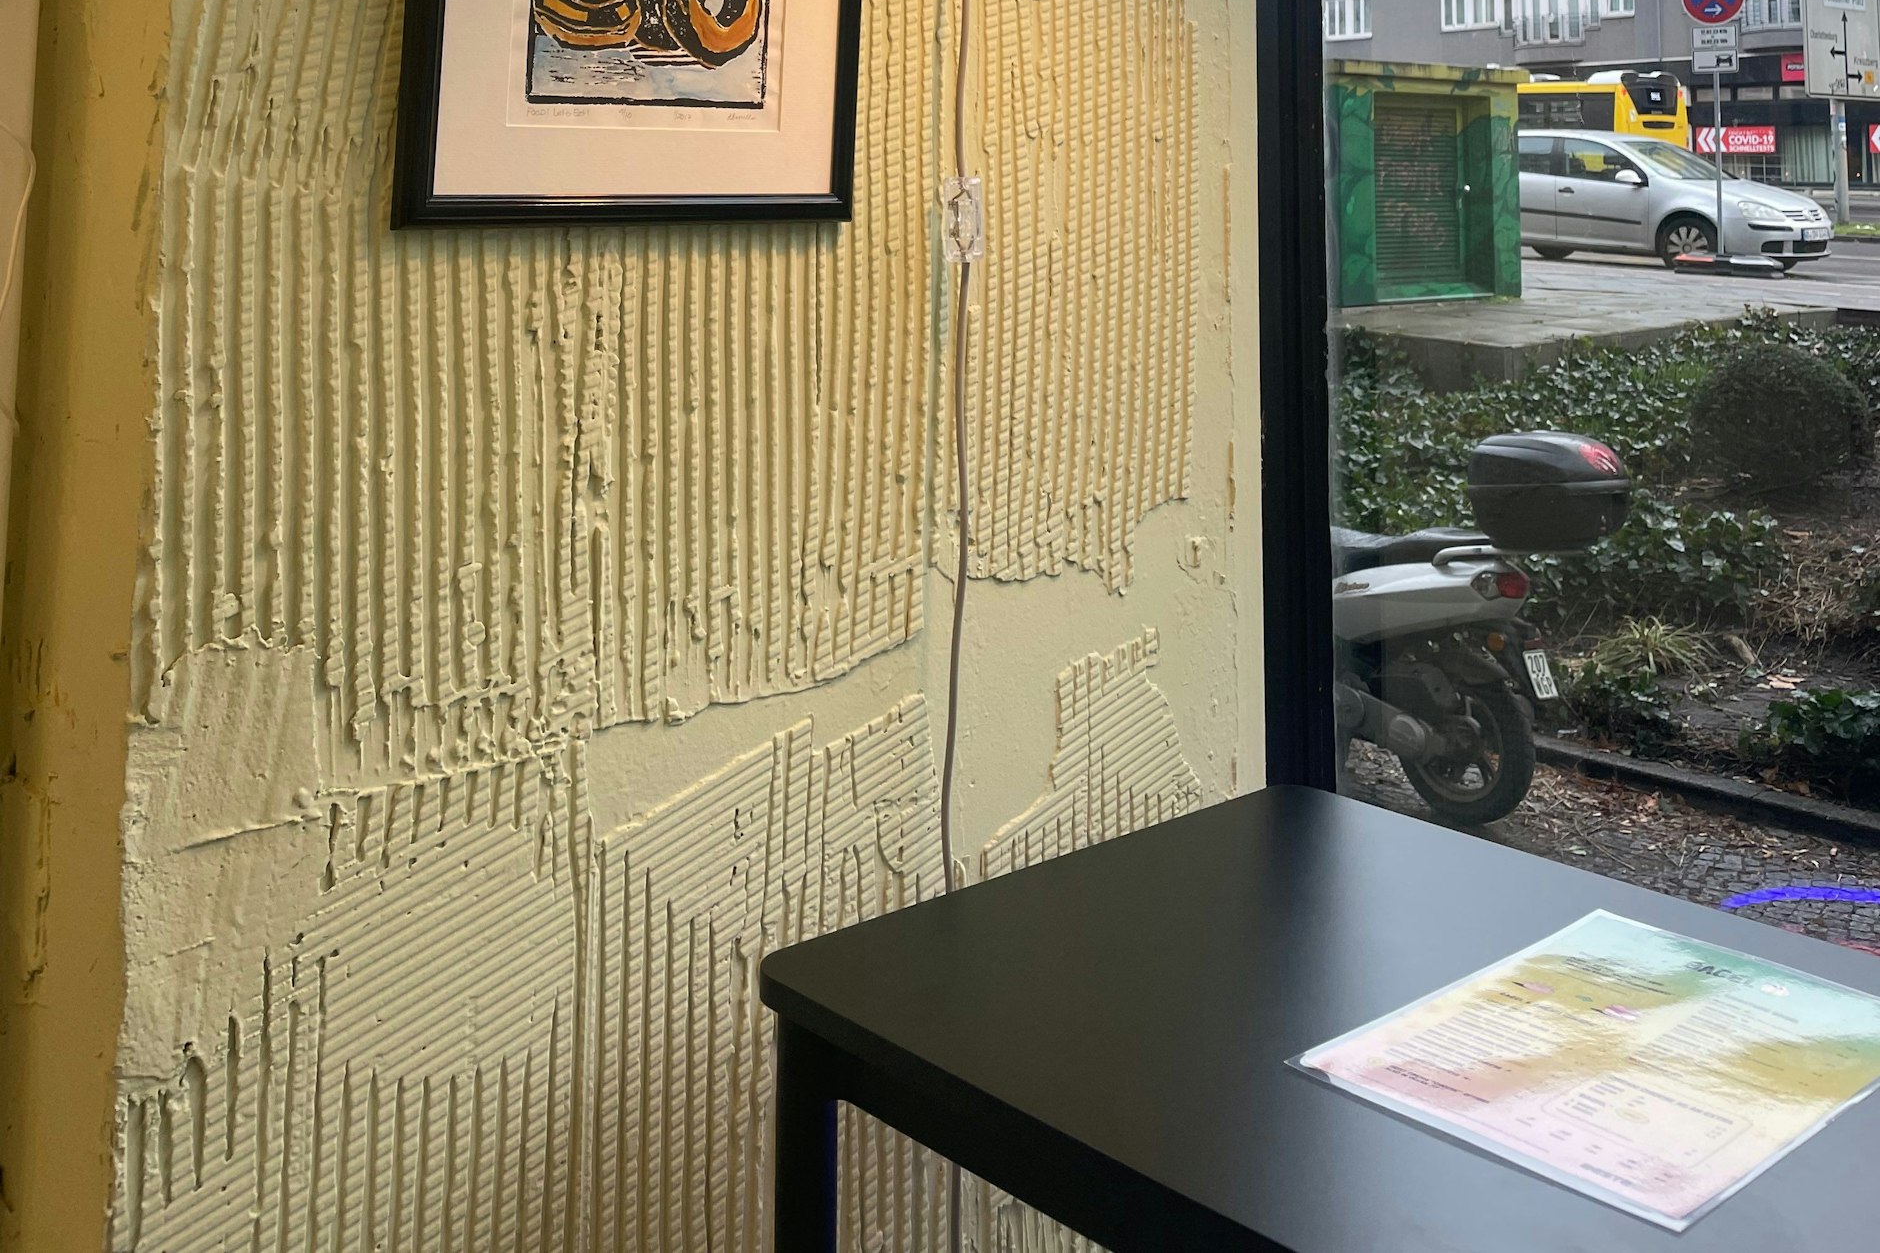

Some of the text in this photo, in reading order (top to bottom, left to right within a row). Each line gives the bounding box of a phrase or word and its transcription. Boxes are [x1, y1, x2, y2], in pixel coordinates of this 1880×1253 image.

[1853, 56, 1879, 69] Kreuzberg
[1728, 134, 1774, 145] COVID-19
[1527, 654, 1546, 677] 207
